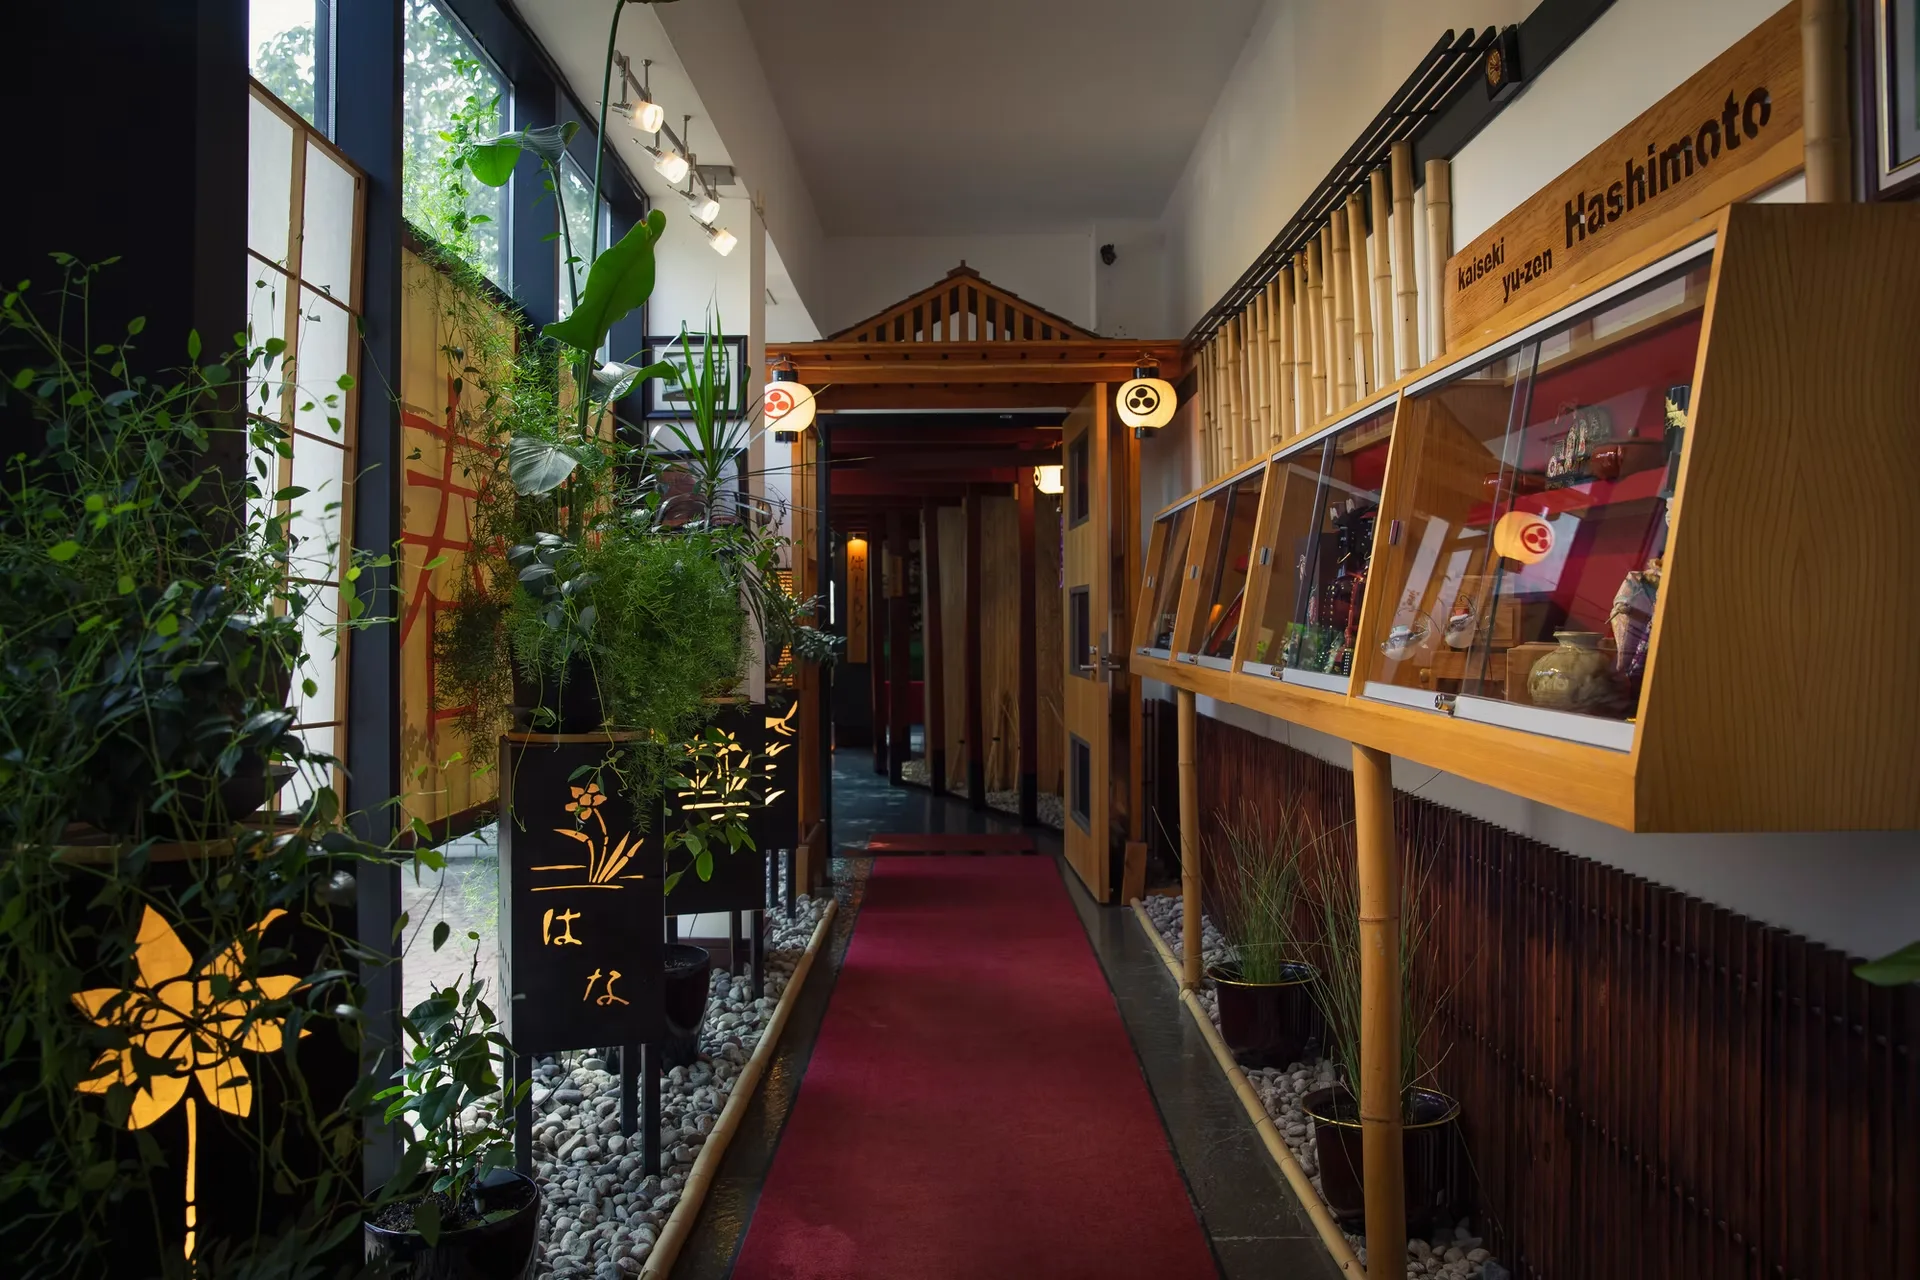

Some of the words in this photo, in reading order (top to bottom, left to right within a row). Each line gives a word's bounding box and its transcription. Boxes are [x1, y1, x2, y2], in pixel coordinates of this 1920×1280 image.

[1502, 246, 1553, 304] yu-zen
[1564, 86, 1772, 249] Hashimoto
[1457, 237, 1506, 293] kaiseki
[542, 908, 630, 1006] はな
